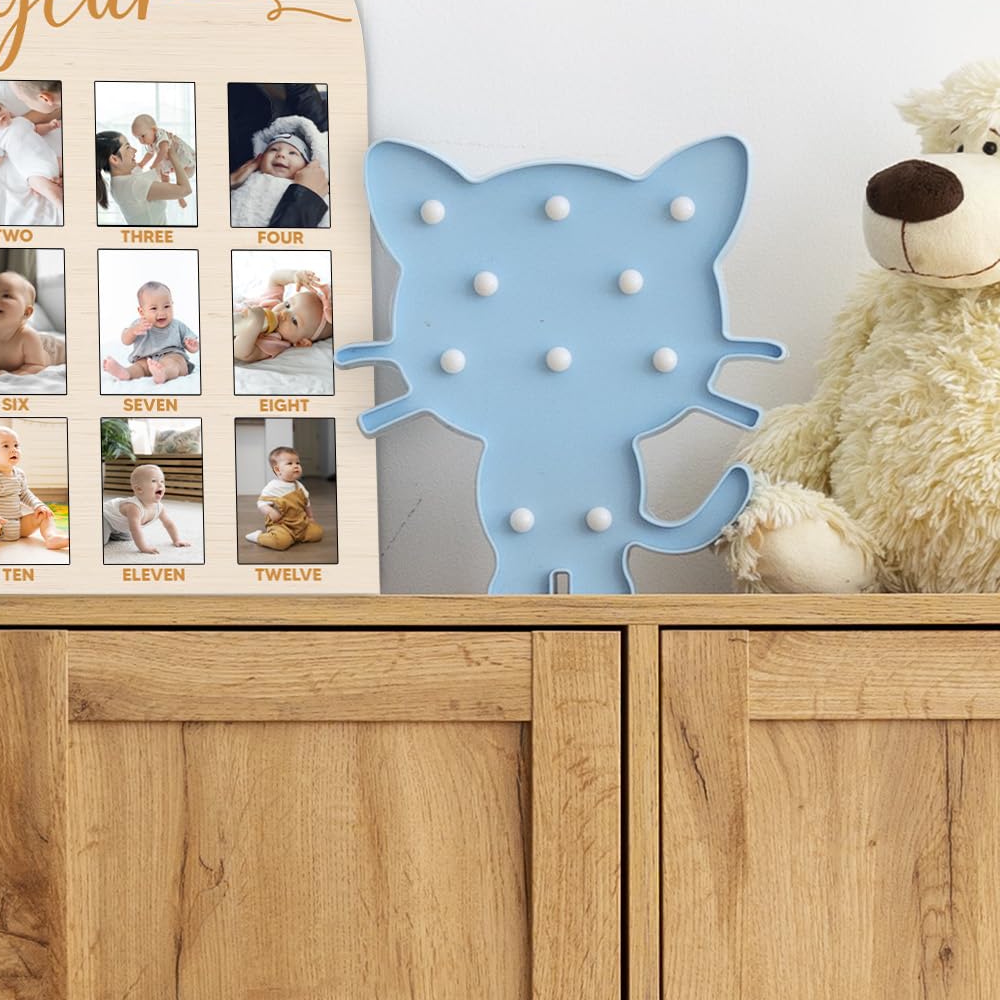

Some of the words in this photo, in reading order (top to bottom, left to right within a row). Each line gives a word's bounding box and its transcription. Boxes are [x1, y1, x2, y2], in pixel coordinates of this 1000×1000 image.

[120, 230, 173, 243] THREE
[257, 231, 304, 245] FOUR
[2, 397, 29, 412] SIX
[123, 398, 178, 412] SEVEN
[259, 399, 309, 413] EIGHT
[2, 567, 35, 582] TEN
[122, 567, 185, 582] ELEVEN
[255, 567, 322, 582] TWELVE
